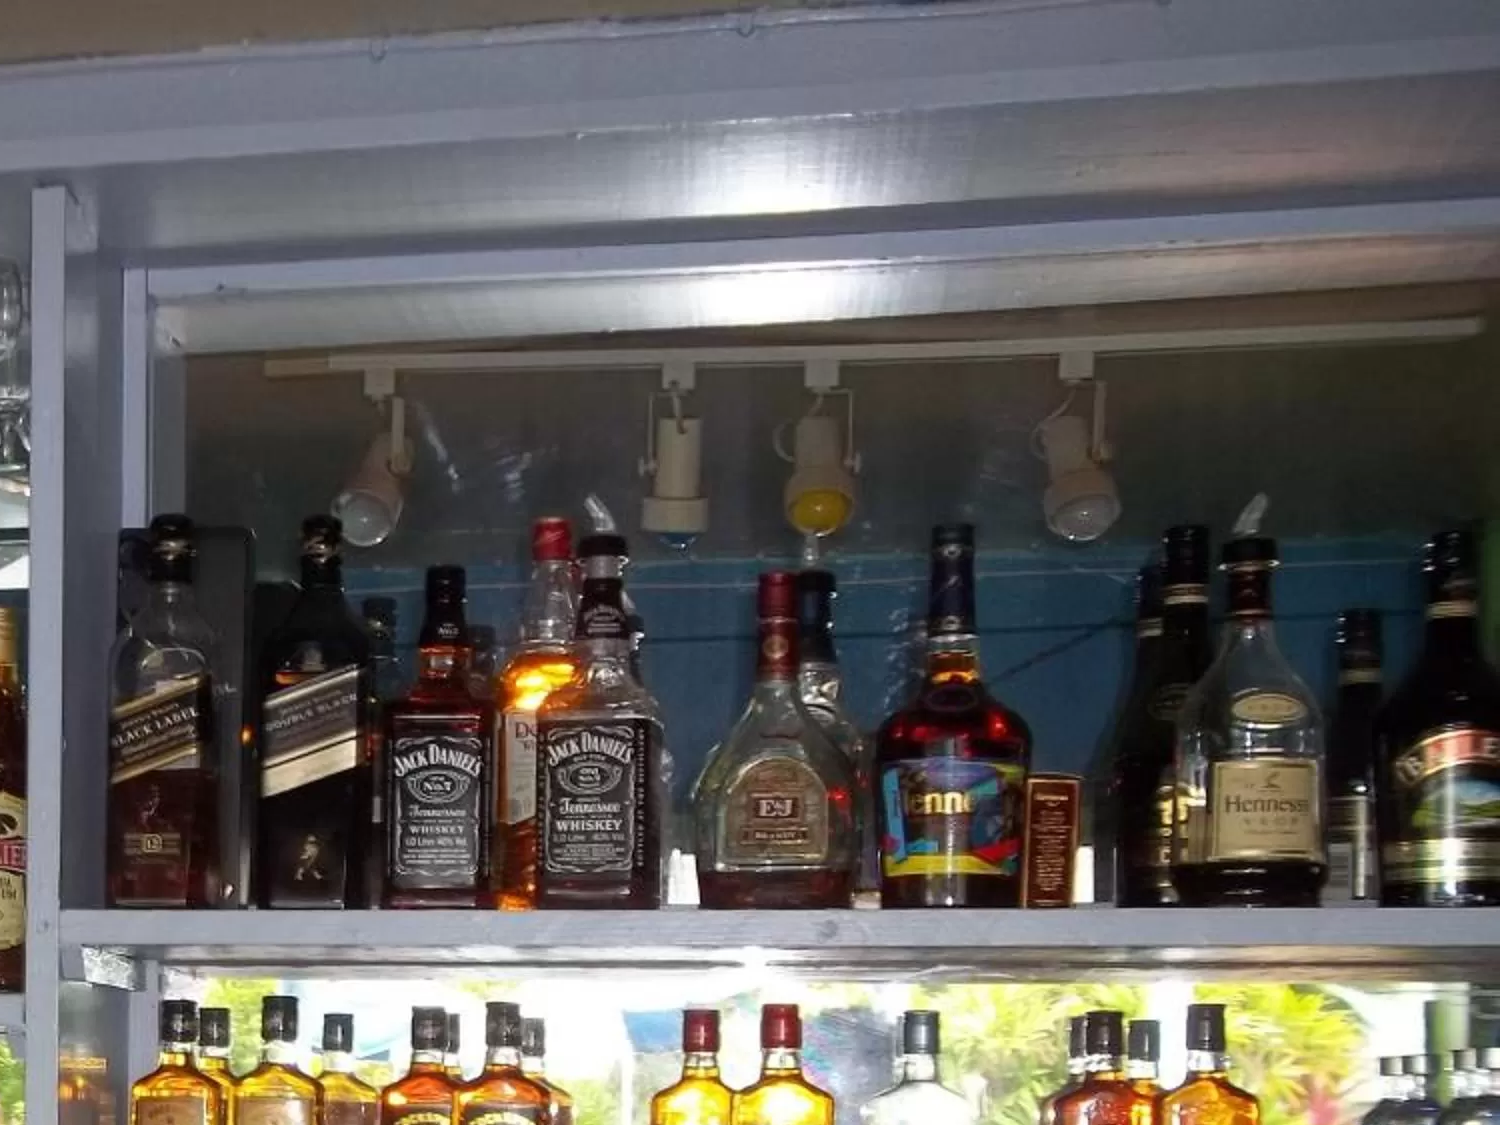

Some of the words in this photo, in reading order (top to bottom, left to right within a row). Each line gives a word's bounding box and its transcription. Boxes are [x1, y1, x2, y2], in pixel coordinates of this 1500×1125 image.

[155, 706, 199, 731] LABEL
[547, 738, 581, 767] JACK
[581, 731, 636, 765] DANIEL'S
[393, 750, 429, 778] JACK
[427, 743, 485, 778] DANIEL'S
[558, 797, 622, 815] Tennessee
[759, 799, 793, 818] E&J
[408, 824, 466, 835] WHISKEY
[555, 818, 623, 833] WHISKEY
